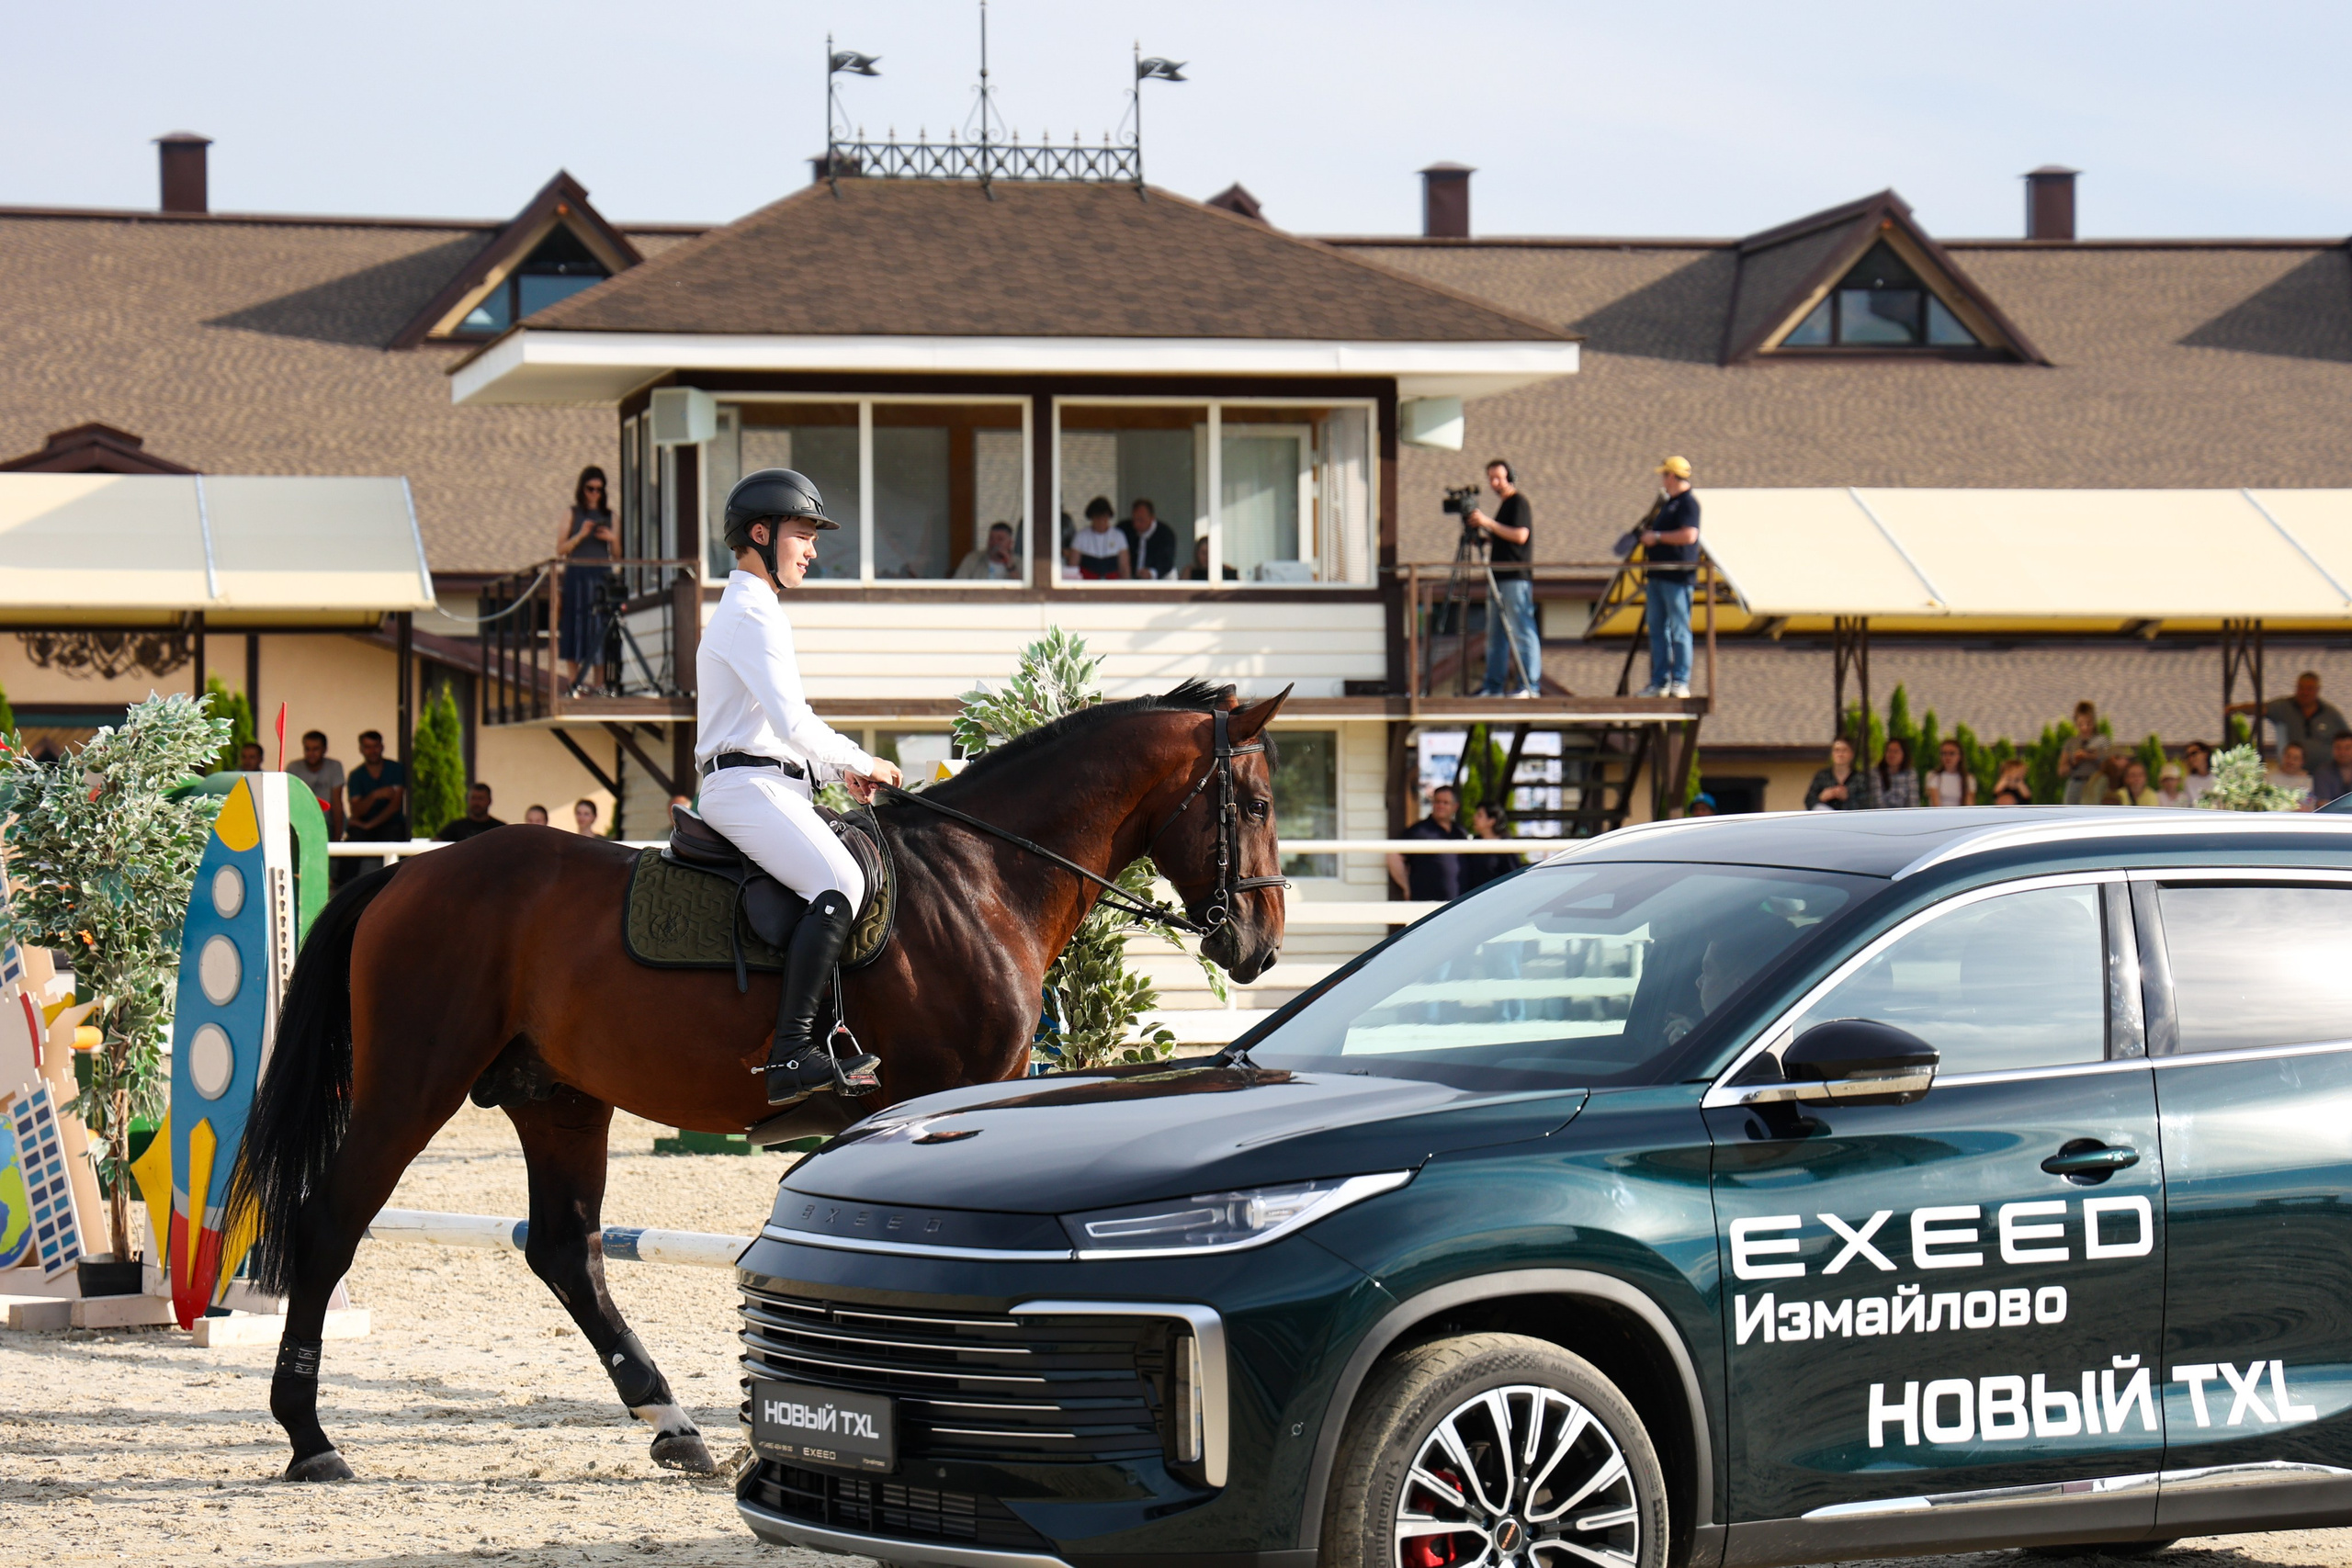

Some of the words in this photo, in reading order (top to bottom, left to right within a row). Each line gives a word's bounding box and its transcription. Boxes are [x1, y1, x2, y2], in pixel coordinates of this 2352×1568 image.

[801, 1204, 942, 1233] EXEED
[1728, 1194, 2155, 1280] EXEED
[1734, 1284, 2067, 1345] Измайлово
[1550, 1362, 1616, 1408] MaxContact
[1867, 1354, 2157, 1448] НОВЫЙ
[2171, 1359, 2318, 1427] TXL
[764, 1399, 837, 1433] НОВЫЙ
[840, 1410, 879, 1439] TXL
[803, 1447, 837, 1461] EXEED
